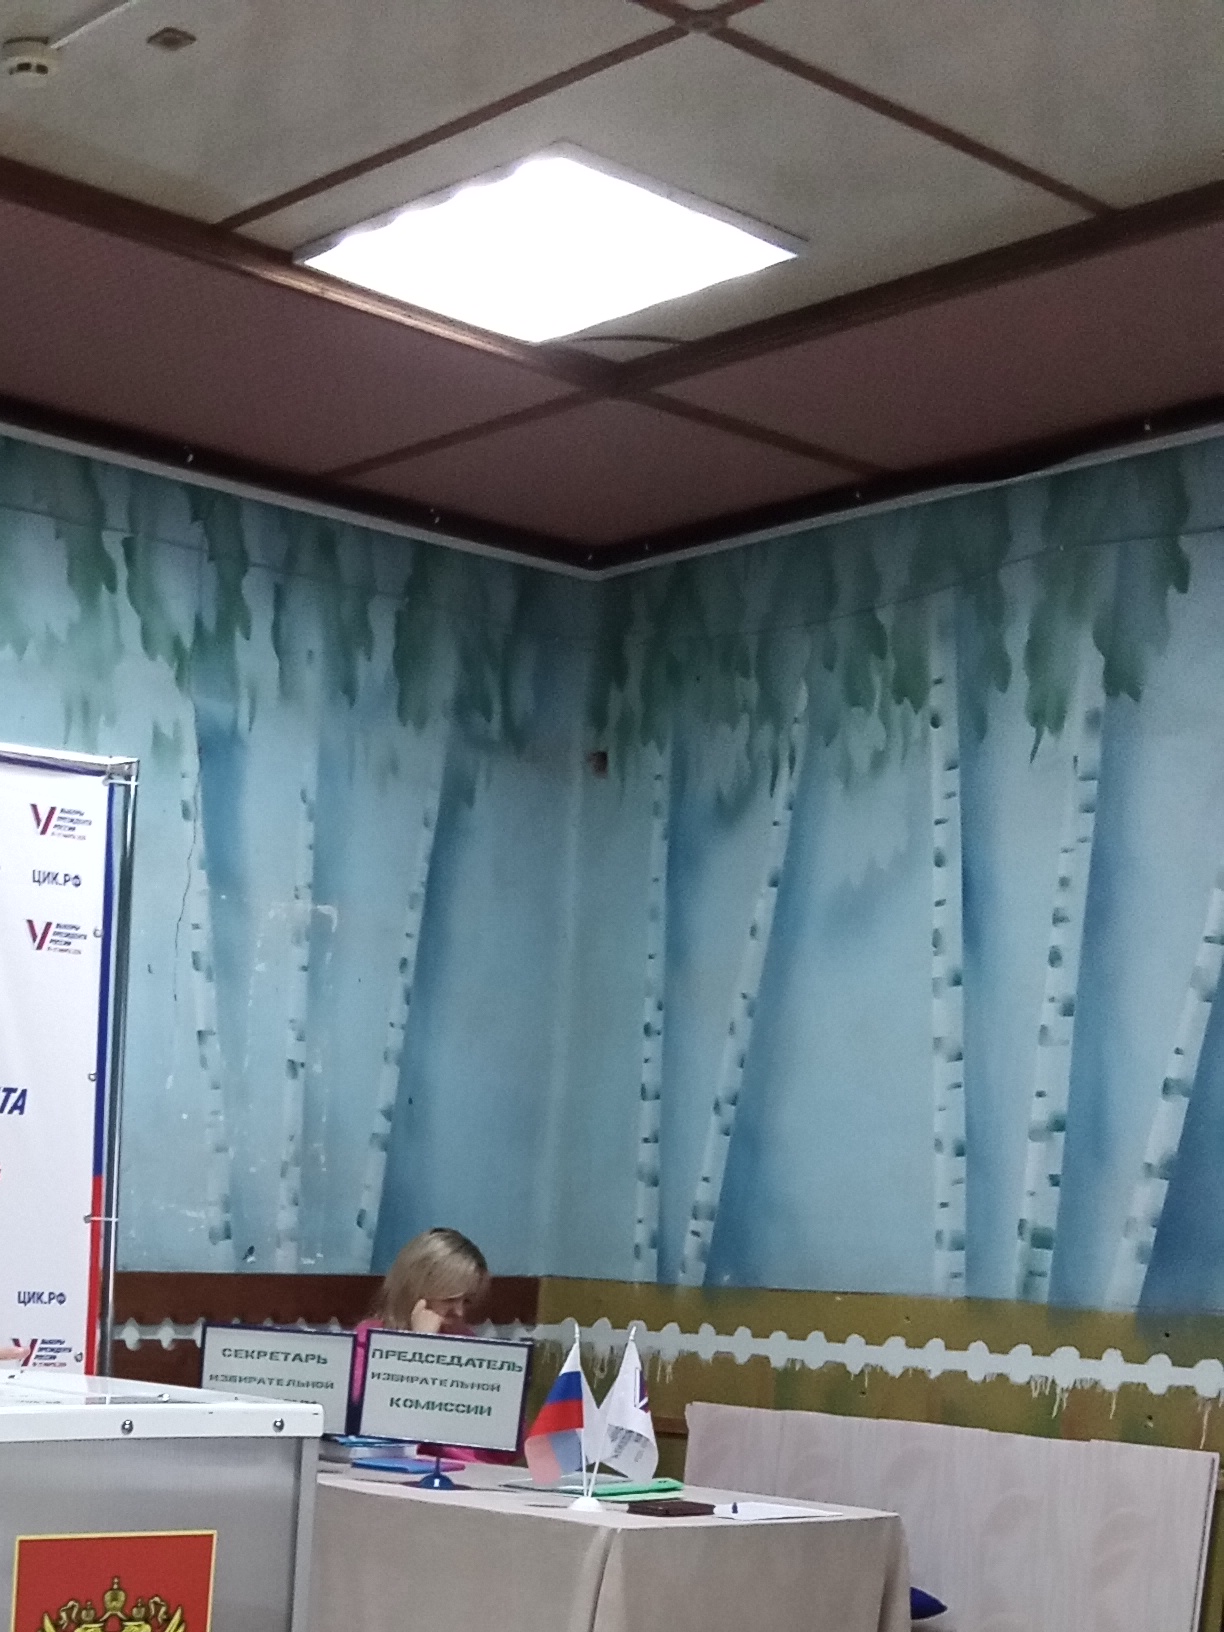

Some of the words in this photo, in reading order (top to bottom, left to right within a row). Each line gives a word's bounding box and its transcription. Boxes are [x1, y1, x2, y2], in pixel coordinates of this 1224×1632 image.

[32, 869, 82, 888] ЦИК.РФ
[17, 1291, 67, 1306] ЦИК.РФ
[221, 1347, 329, 1365] СЕКРЕТАРЬ
[371, 1348, 524, 1373] ПРЕДСЕДАТЕЛЬ
[208, 1373, 335, 1390] ИЗБИРАТЕЛЬНОЙ
[370, 1371, 502, 1393] ИЗБИРАТЕЛЬНОЙ
[389, 1397, 493, 1417] КОМИССИИ
